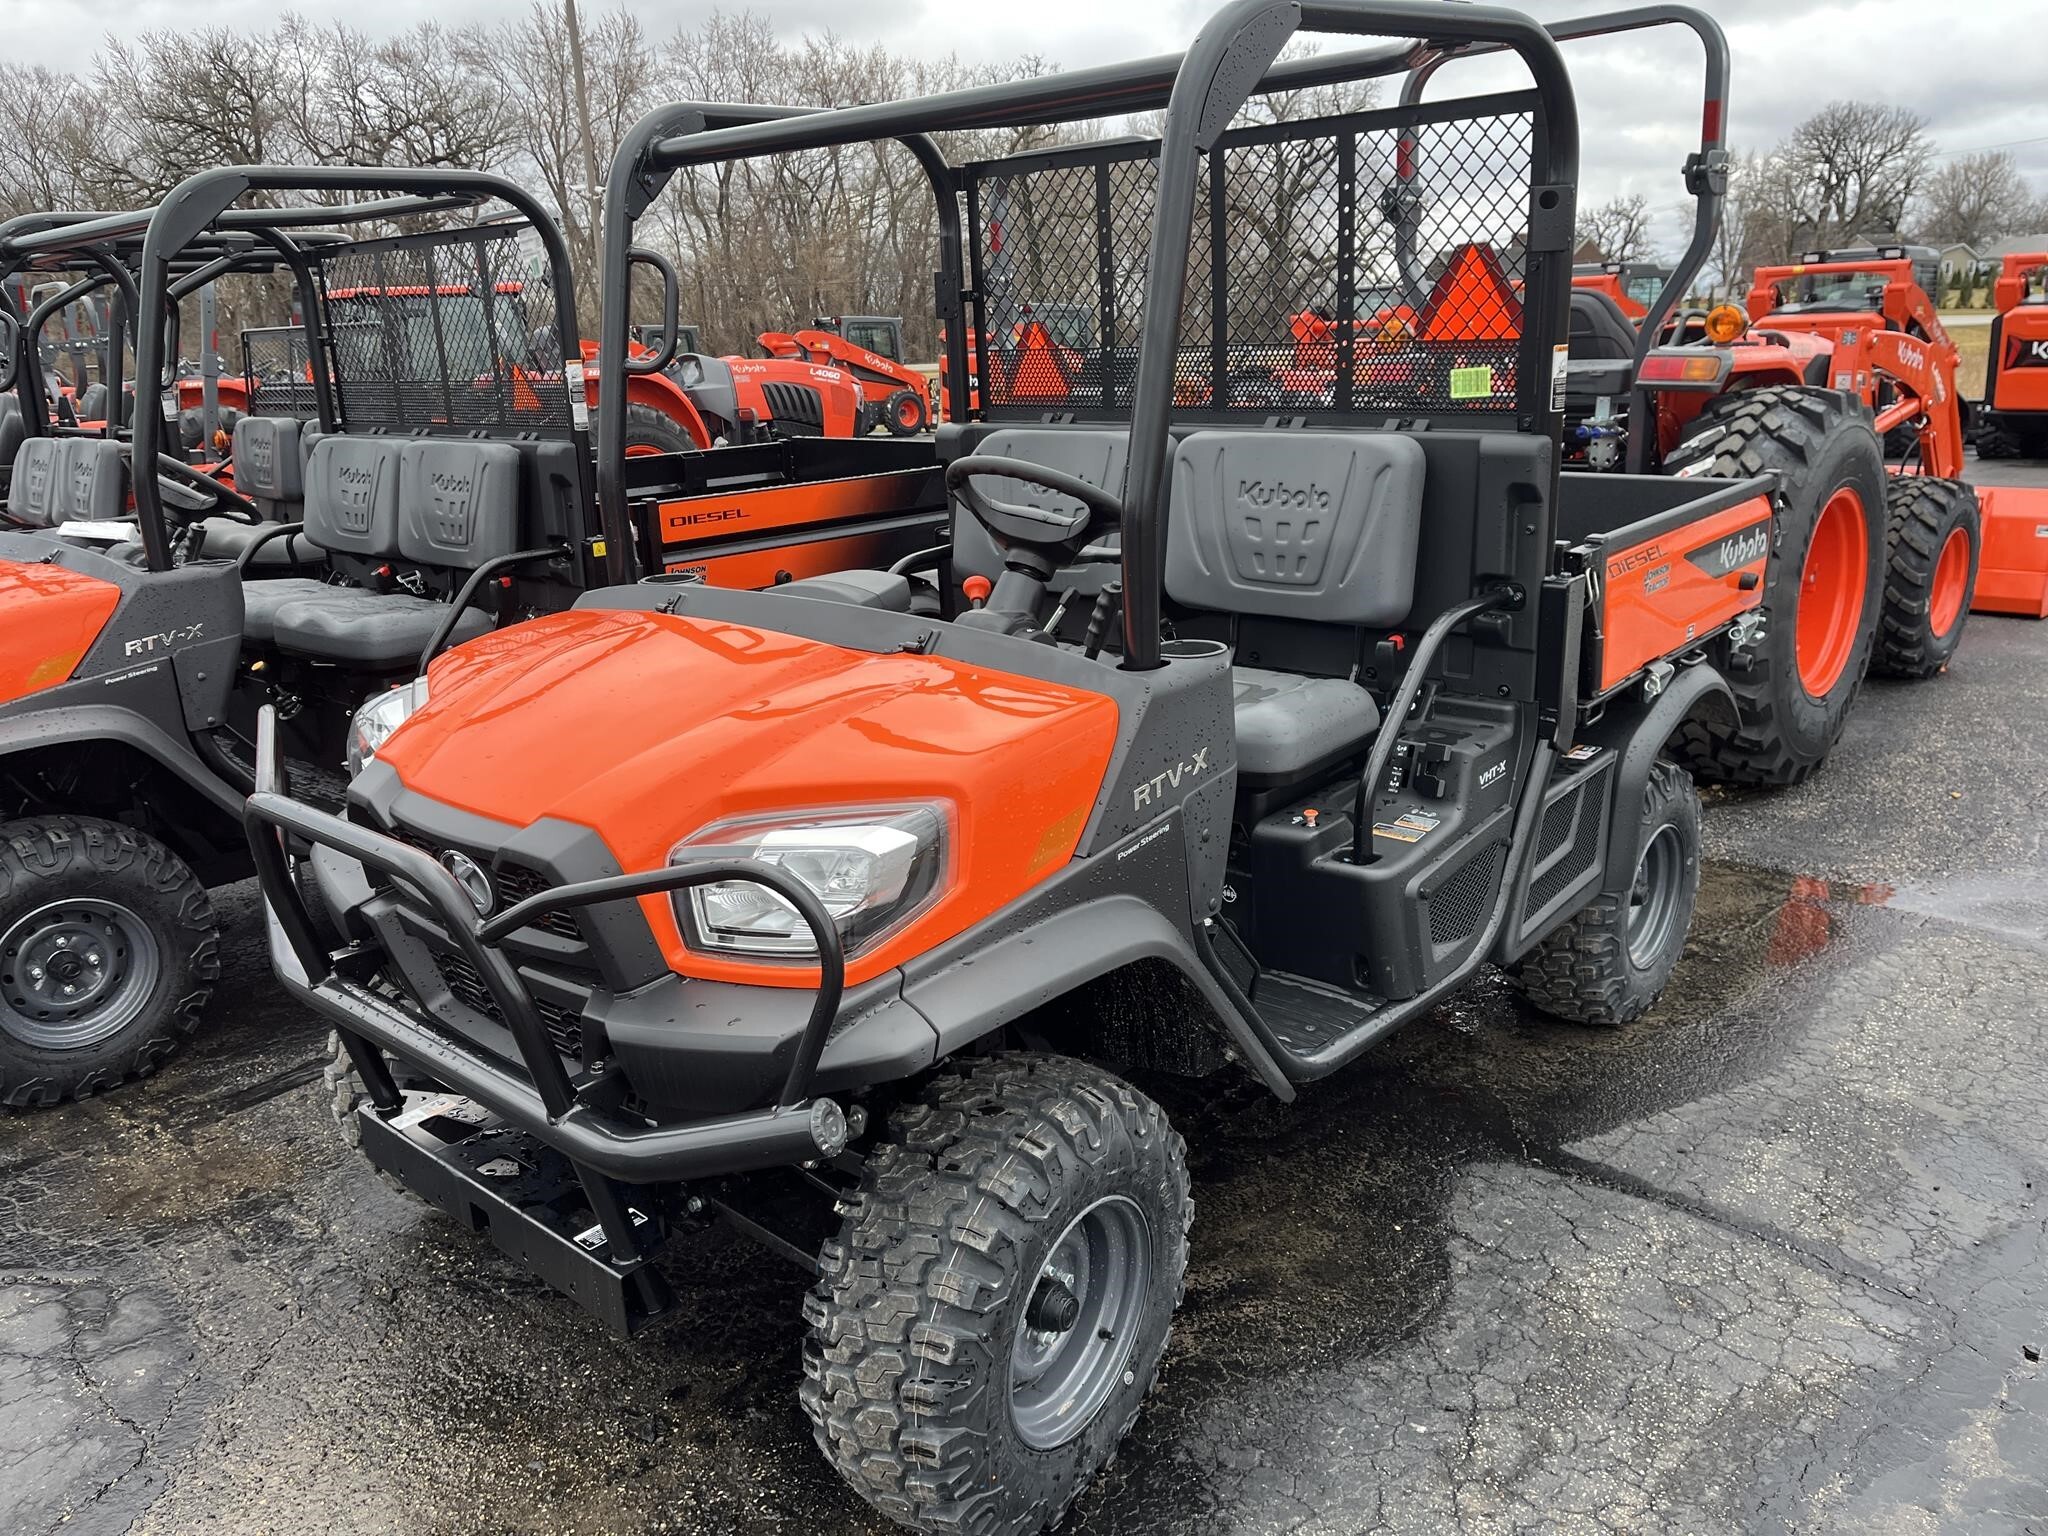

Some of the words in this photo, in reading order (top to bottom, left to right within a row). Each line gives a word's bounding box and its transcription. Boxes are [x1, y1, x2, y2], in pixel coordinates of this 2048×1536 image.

[732, 364, 767, 373] Kubota
[810, 368, 841, 381] L4060
[864, 352, 895, 374] Kubota
[339, 467, 372, 485] Kubota
[430, 473, 470, 493] Kubota
[1238, 480, 1330, 511] Kubota
[669, 508, 751, 529] DIESEL
[1719, 527, 1768, 569] Kubota
[1608, 545, 1668, 578] DIESEL
[124, 623, 203, 656] RTV-X
[105, 676, 126, 685] Power
[127, 666, 158, 679] Steering
[1133, 746, 1208, 812] RTV-X
[1479, 760, 1507, 786] VHT-X
[1117, 841, 1140, 861] Power
[1139, 823, 1170, 847] Steering
